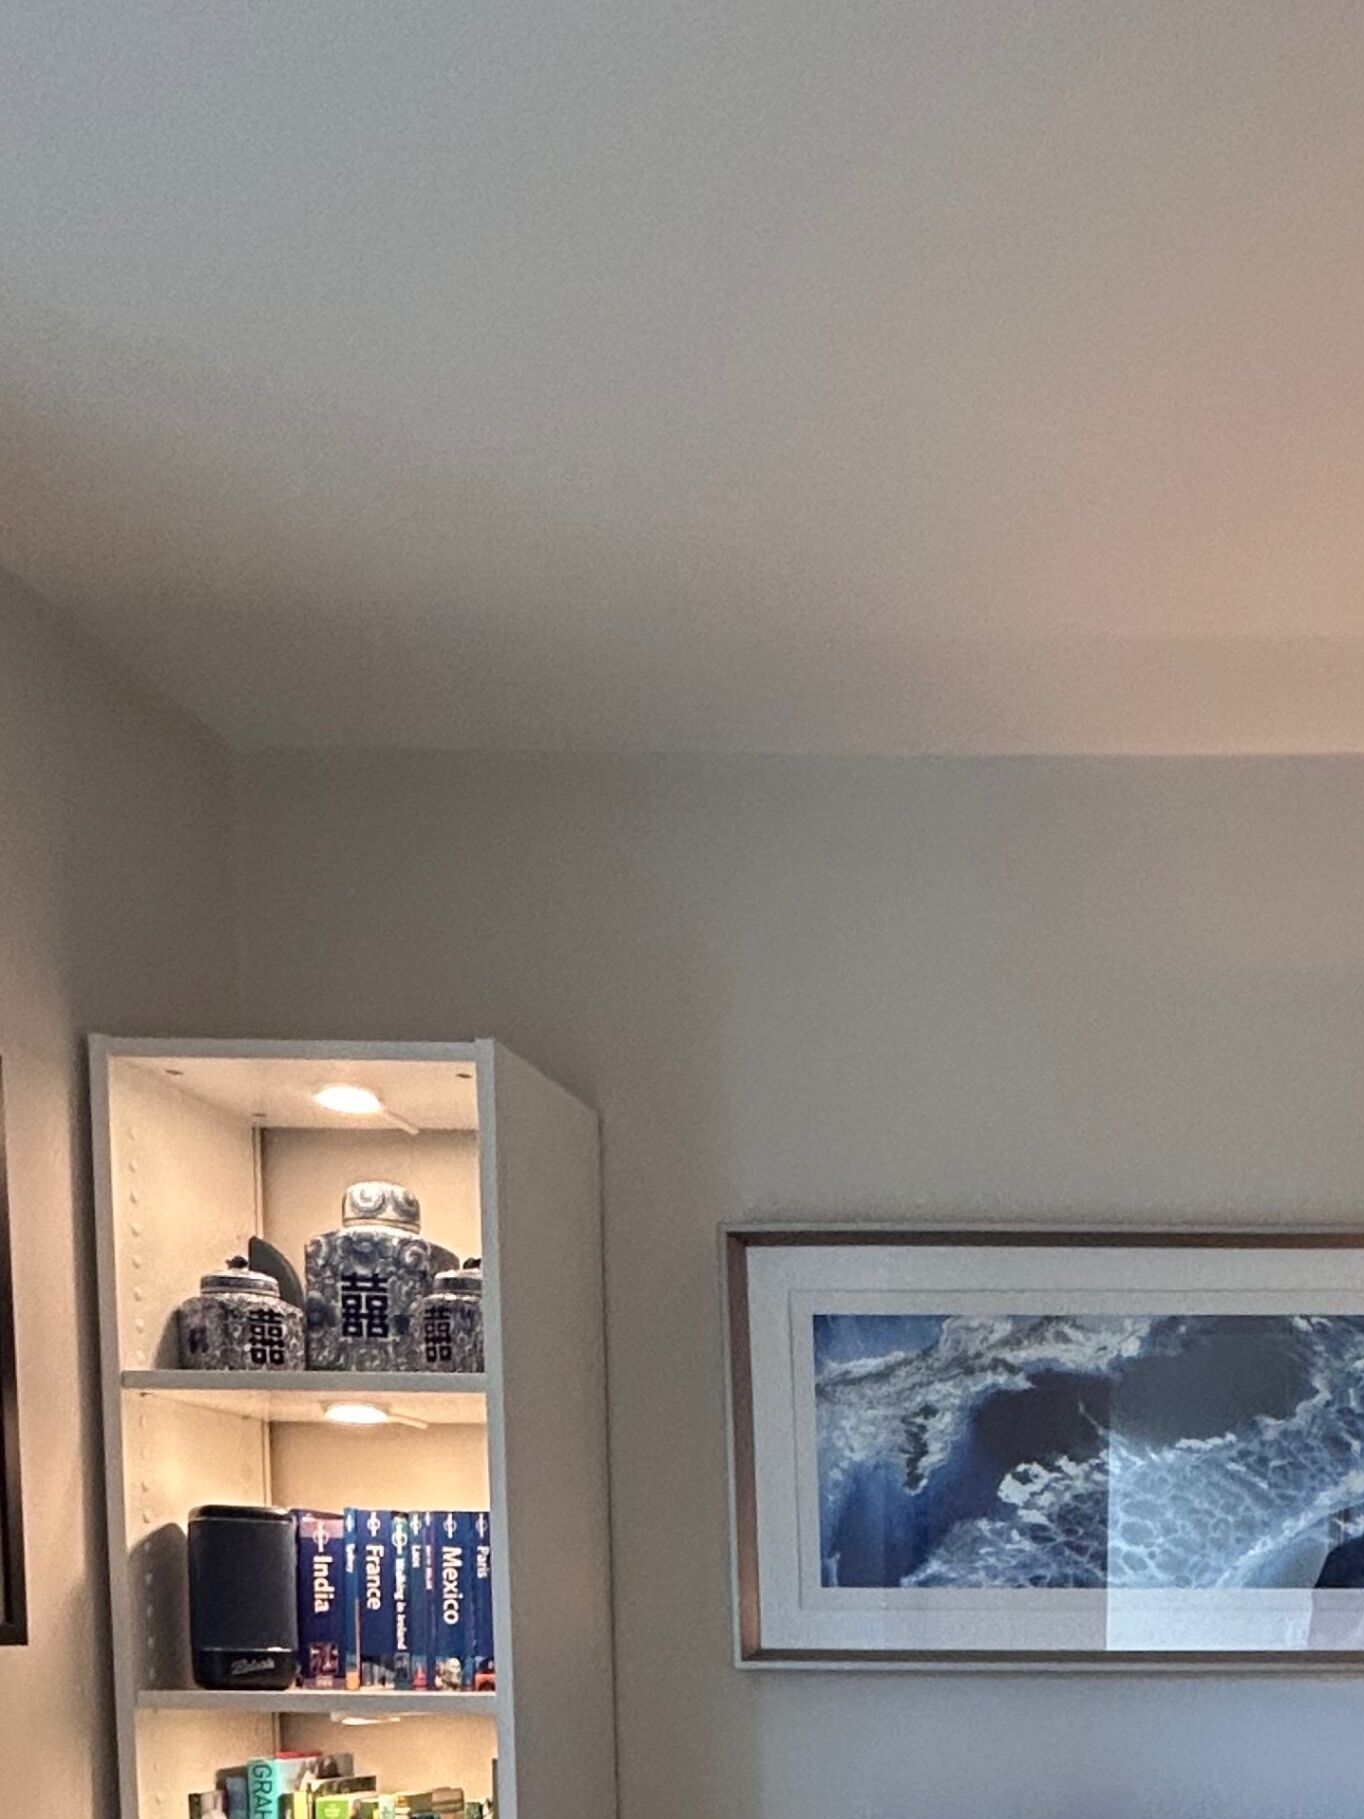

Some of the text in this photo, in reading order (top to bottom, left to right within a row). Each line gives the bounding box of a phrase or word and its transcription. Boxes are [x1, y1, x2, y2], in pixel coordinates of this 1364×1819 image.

[313, 1555, 335, 1613] India
[365, 1544, 385, 1610] France
[442, 1546, 463, 1625] Mexico
[476, 1545, 490, 1578] Paris
